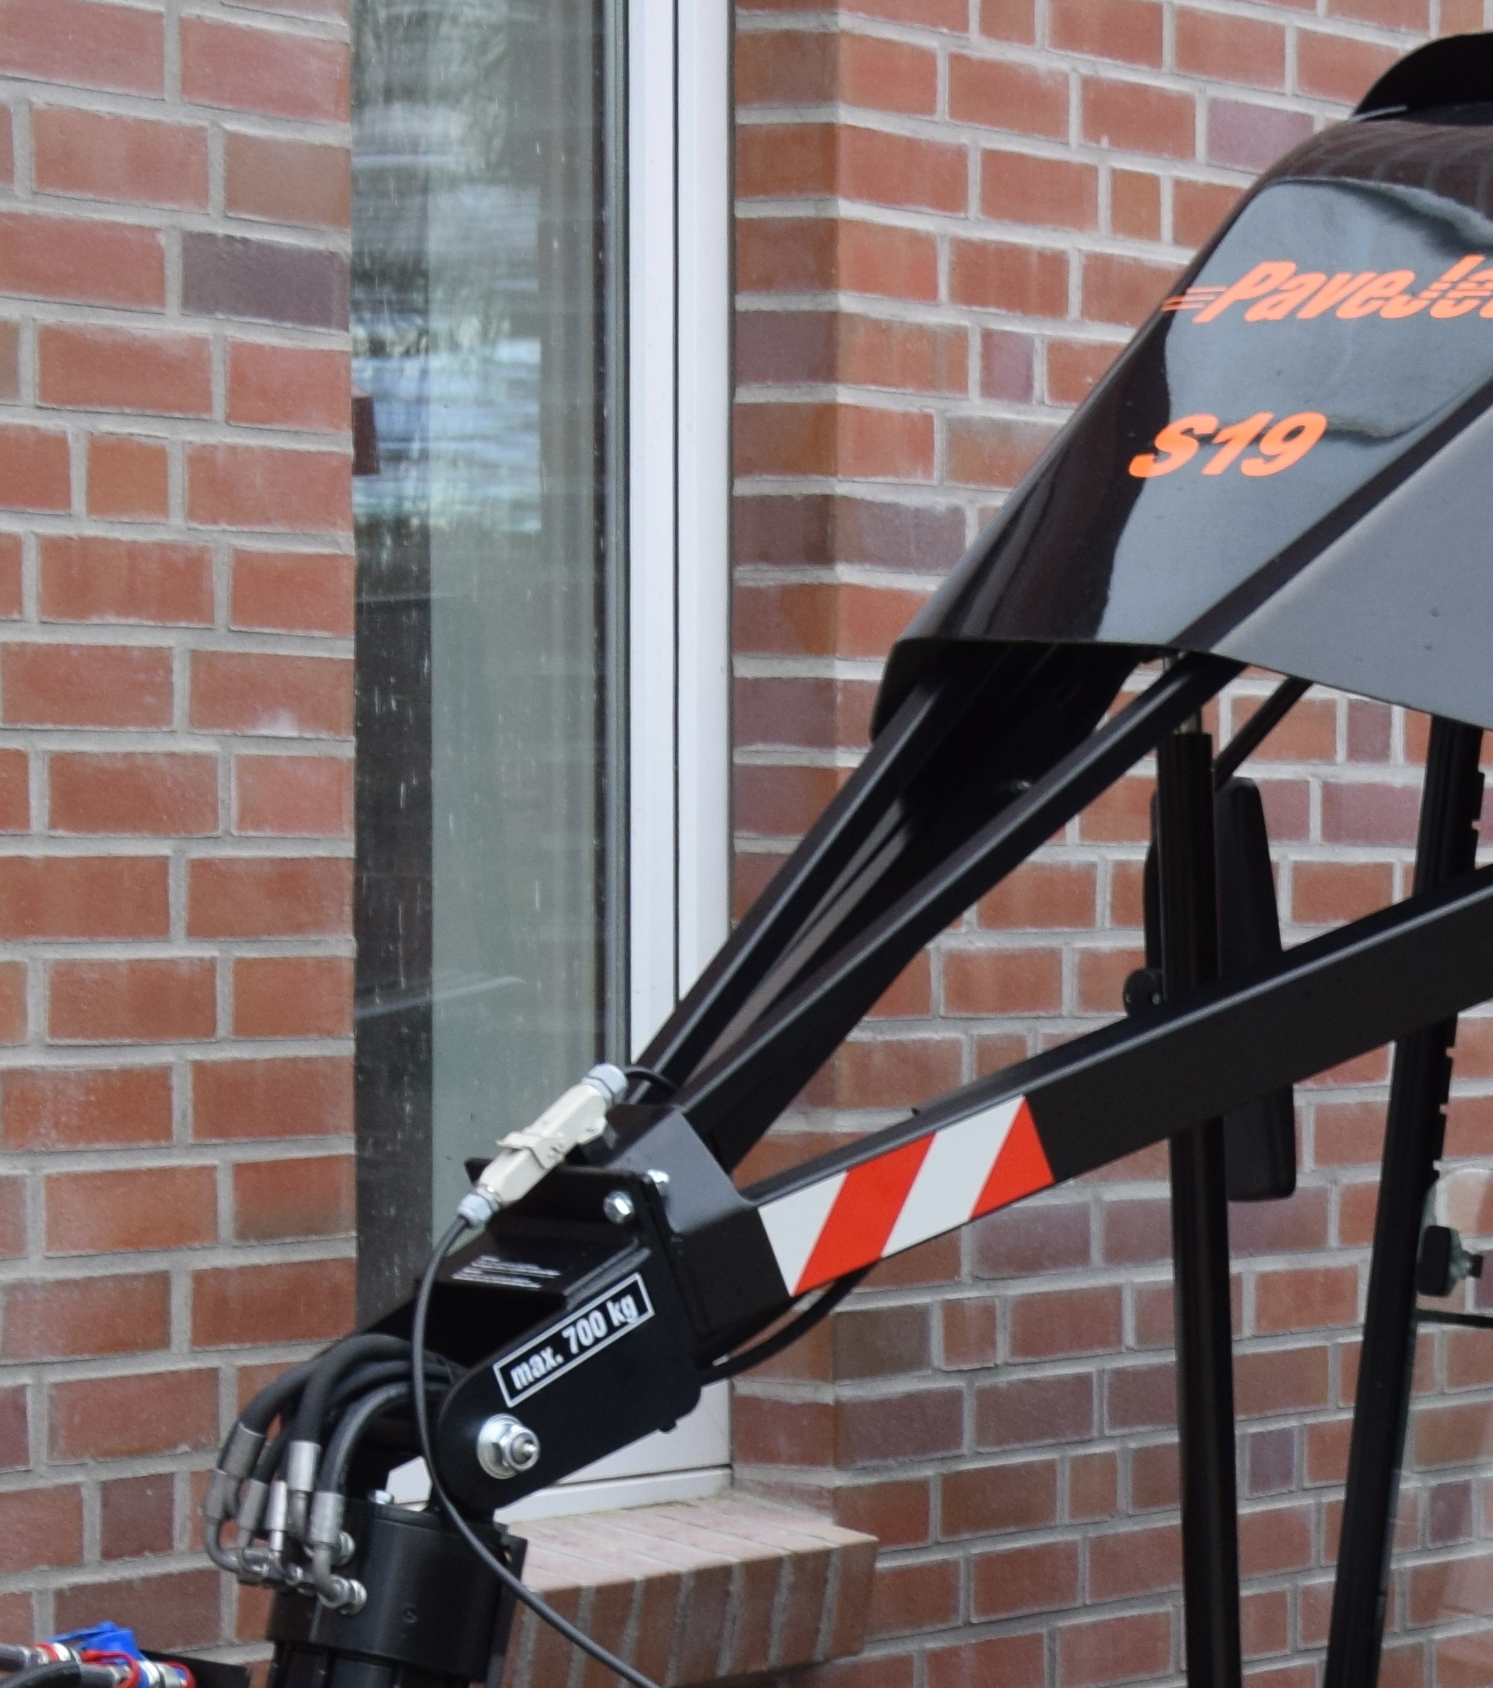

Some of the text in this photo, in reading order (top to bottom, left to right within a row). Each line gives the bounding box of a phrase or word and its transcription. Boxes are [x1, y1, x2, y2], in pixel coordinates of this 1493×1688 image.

[1128, 412, 1327, 478] S19
[509, 1293, 639, 1391] max. 700 kg
